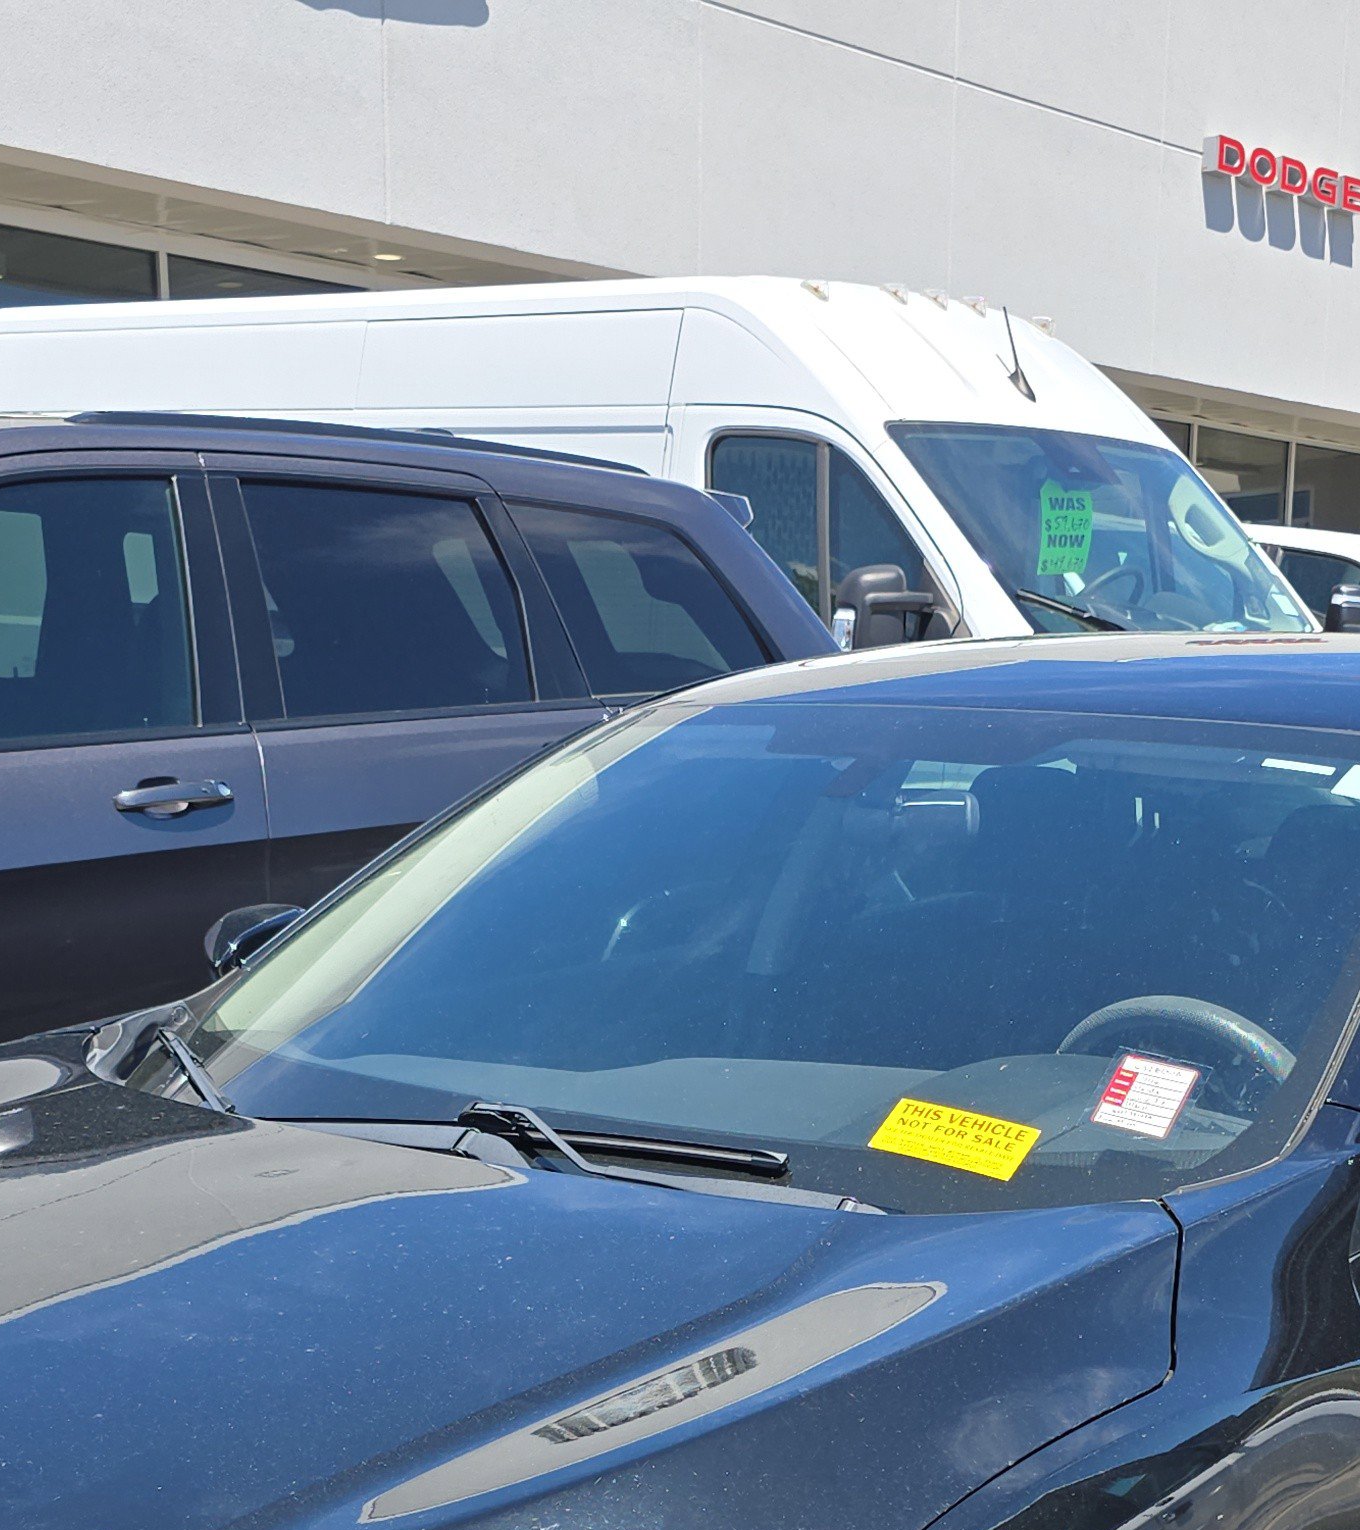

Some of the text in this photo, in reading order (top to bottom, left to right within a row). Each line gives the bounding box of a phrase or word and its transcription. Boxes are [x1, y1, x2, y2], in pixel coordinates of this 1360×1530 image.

[1048, 497, 1086, 511] WAS
[1046, 534, 1085, 548] NOW
[896, 1117, 931, 1130] NOT
[934, 1125, 968, 1140] FOR
[972, 1134, 1016, 1152] SALE
[902, 1103, 1028, 1142] THIS VEHICLE
